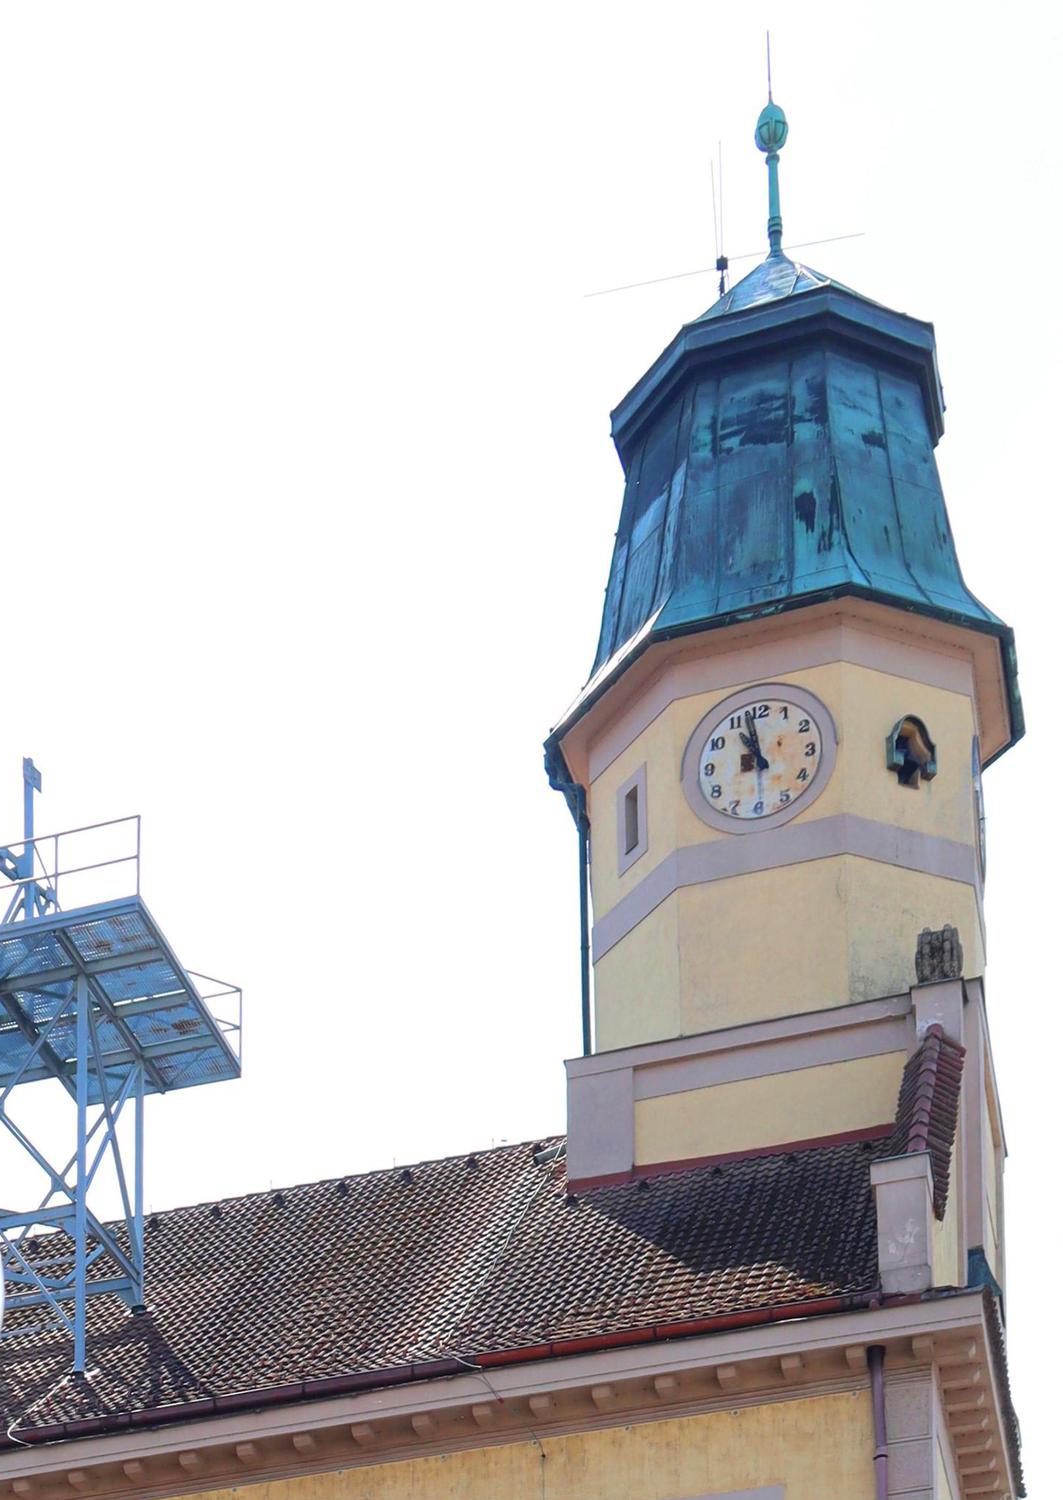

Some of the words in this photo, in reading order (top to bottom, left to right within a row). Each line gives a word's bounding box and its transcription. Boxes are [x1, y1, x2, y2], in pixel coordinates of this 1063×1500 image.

[751, 704, 770, 720] 12
[779, 706, 789, 720] 1
[729, 716, 742, 730] 11
[798, 719, 810, 733] 2
[710, 736, 726, 751] 10
[804, 742, 816, 757] 3
[704, 763, 715, 777] 9
[796, 768, 809, 782] 4
[710, 784, 722, 798] 8
[779, 789, 791, 803] 5
[729, 800, 740, 816] 7
[753, 801, 764, 815] 6
